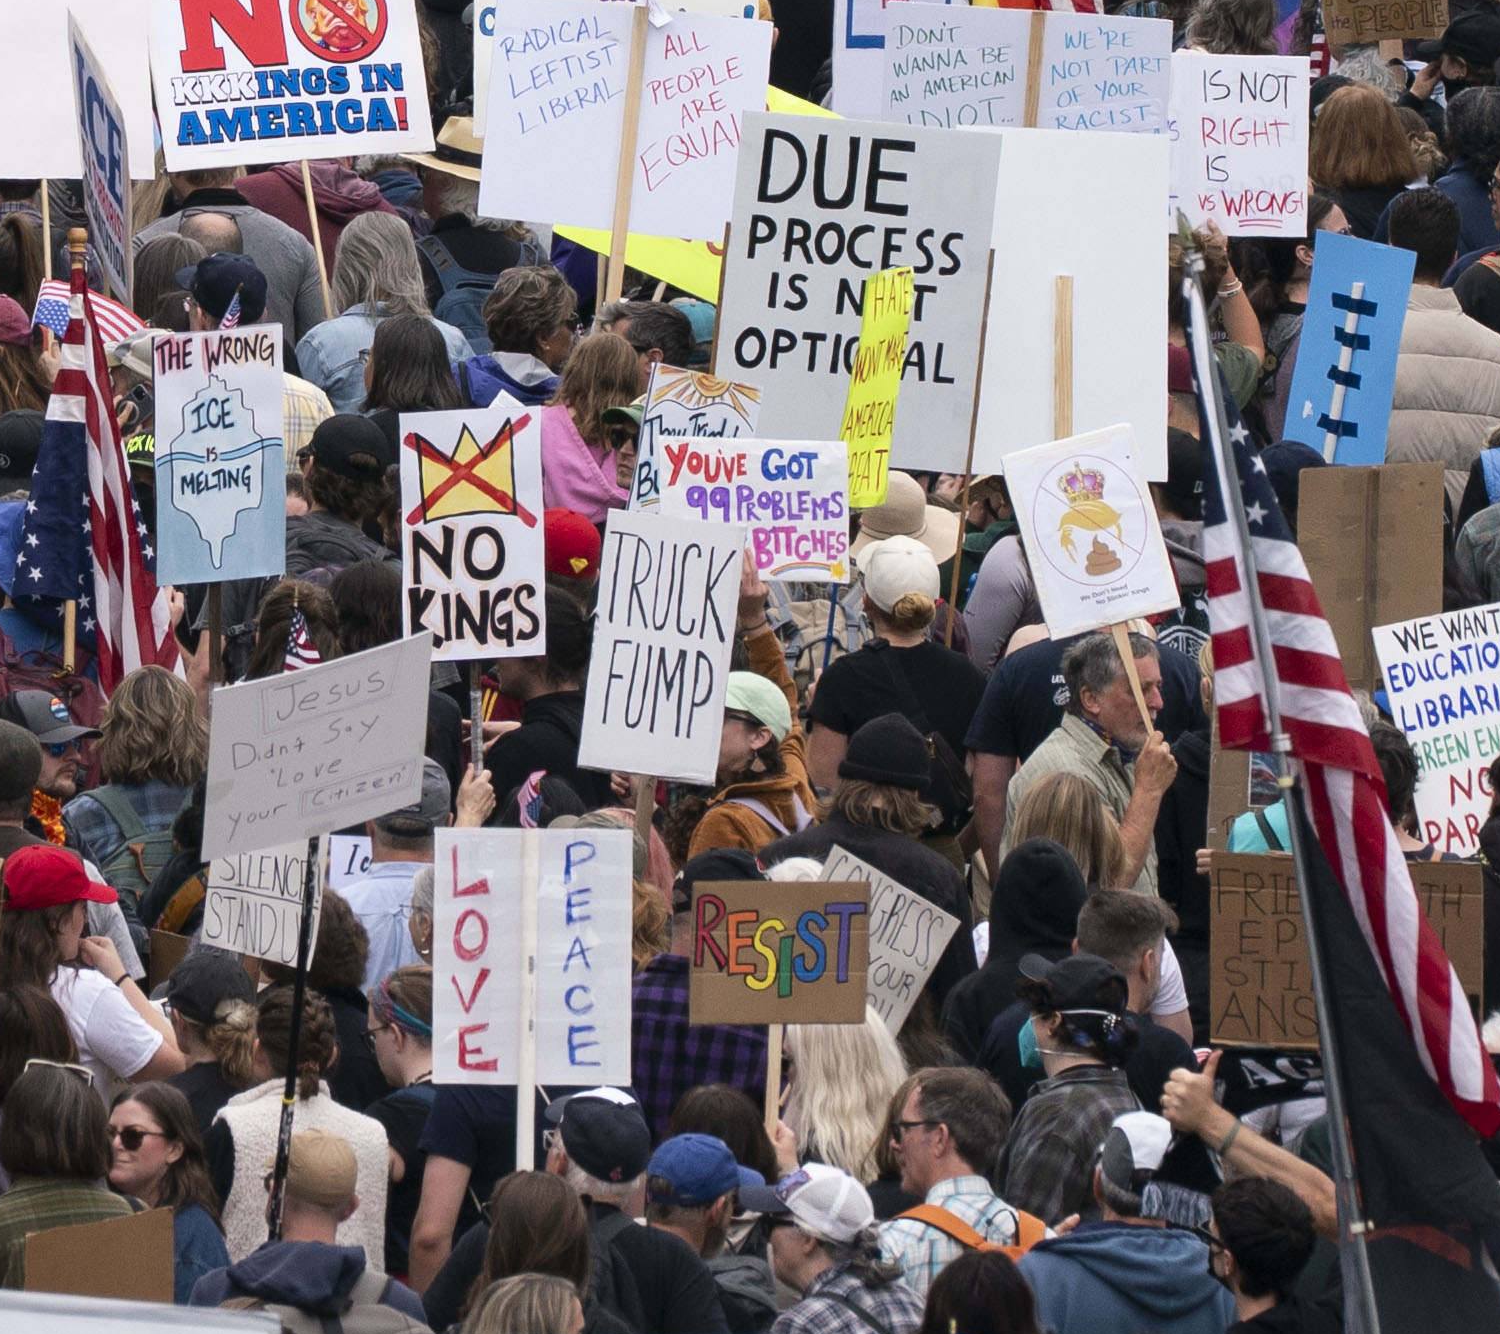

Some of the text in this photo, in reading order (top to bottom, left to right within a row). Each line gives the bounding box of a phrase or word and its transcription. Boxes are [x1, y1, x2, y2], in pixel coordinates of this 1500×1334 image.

[500, 15, 612, 62] RADICAL
[758, 128, 916, 219] DUE
[191, 398, 235, 434] ICE
[180, 465, 253, 497] MELTING
[409, 581, 541, 650] KINGS
[606, 529, 736, 642] TRUCK
[602, 637, 714, 739] FUMP
[694, 892, 869, 998] RESIST
